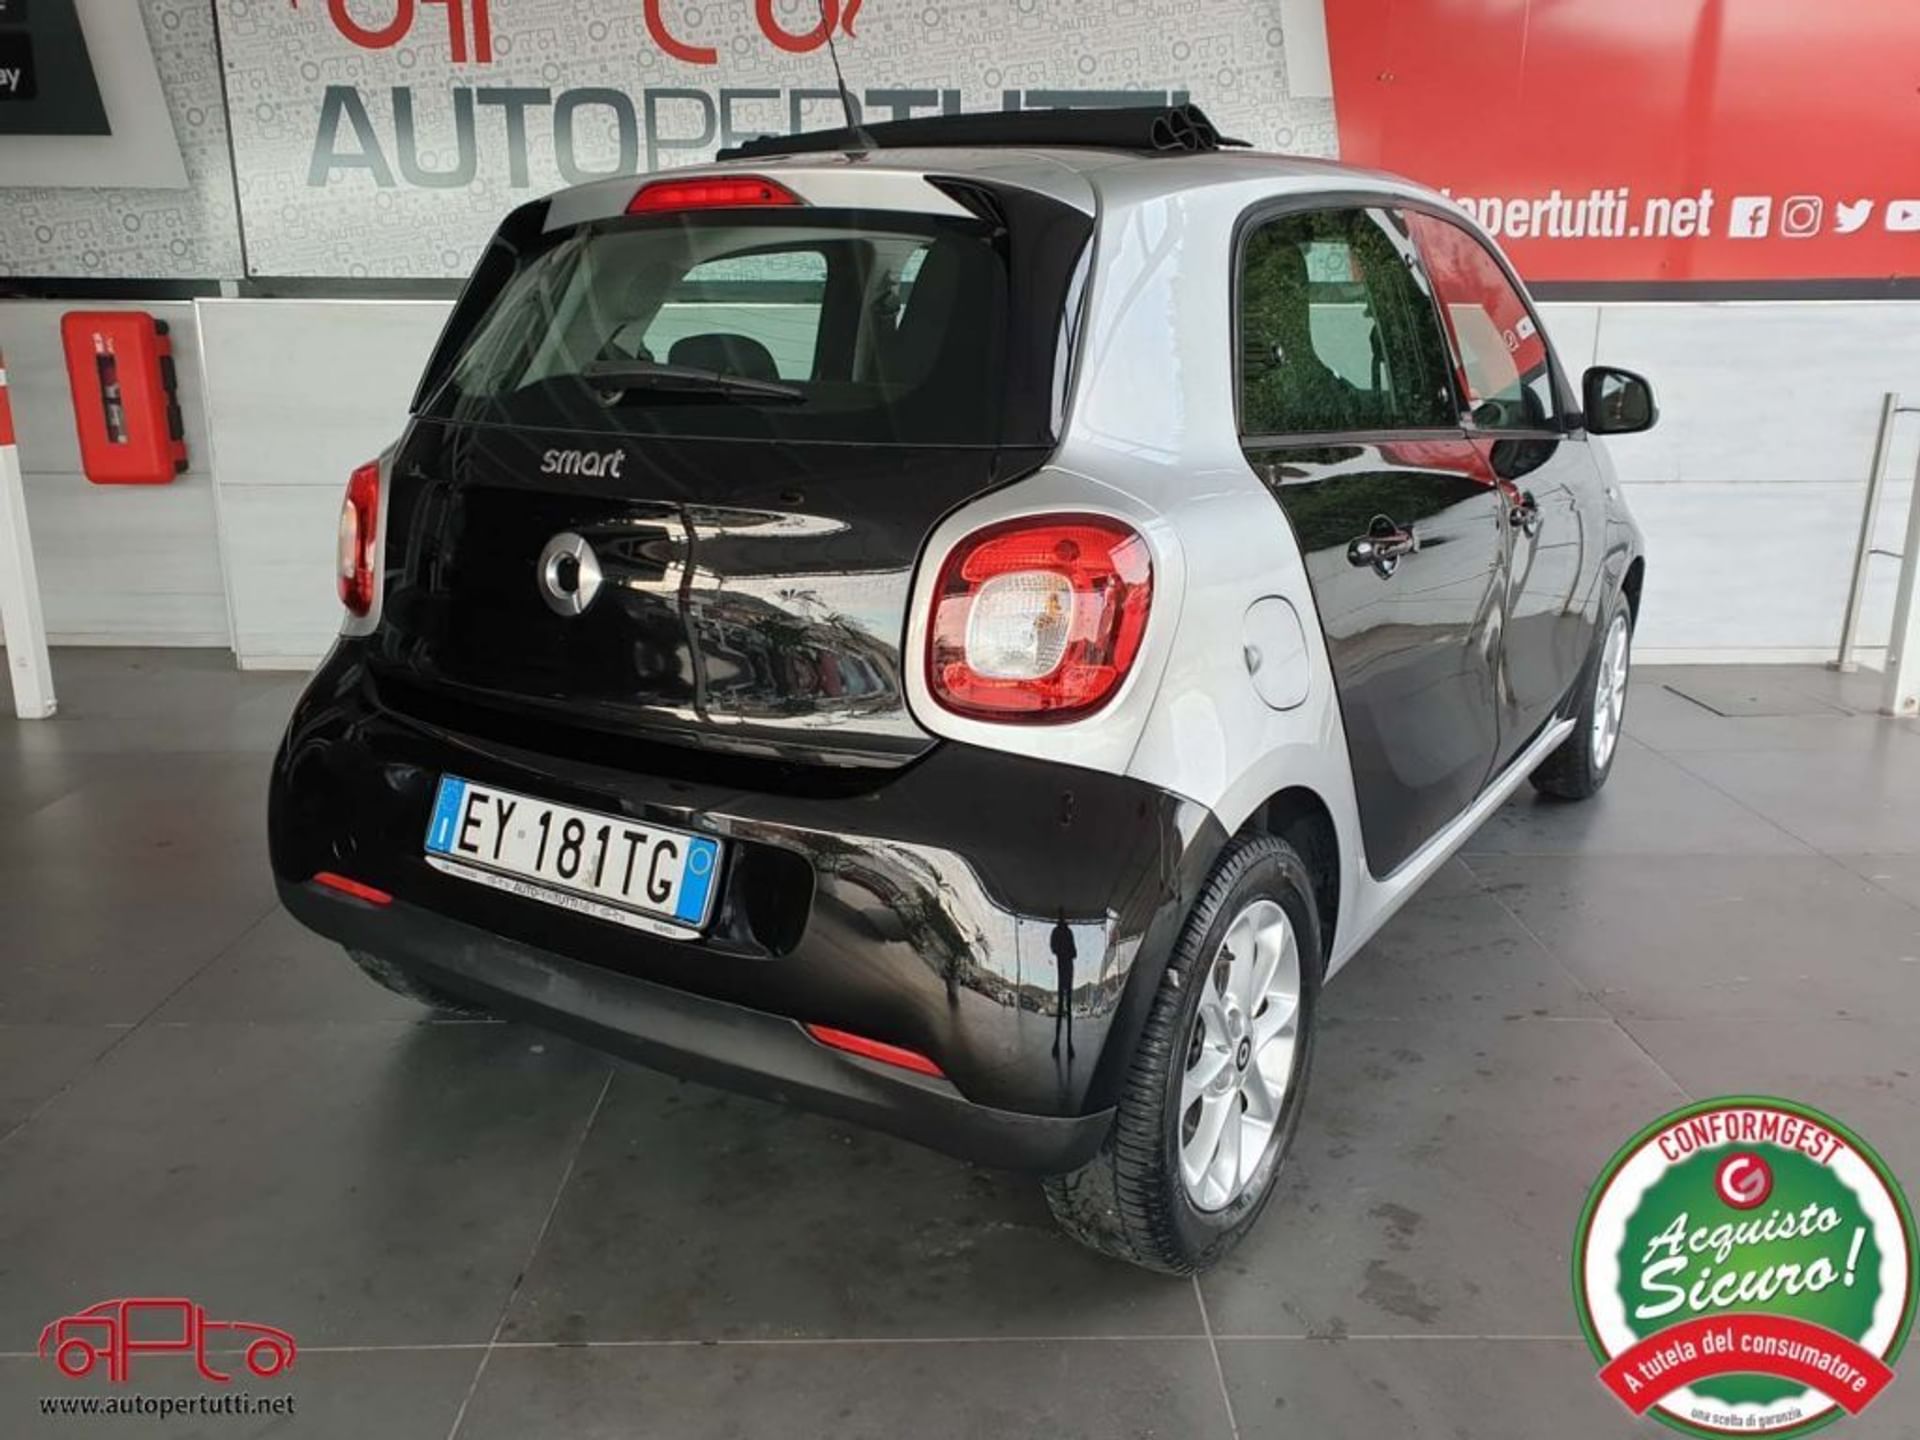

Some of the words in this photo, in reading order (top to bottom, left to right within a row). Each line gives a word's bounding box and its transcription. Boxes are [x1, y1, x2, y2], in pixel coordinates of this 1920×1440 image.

[307, 86, 1191, 188] AUTOPE
[1440, 188, 1713, 238] opertutti.net
[540, 449, 625, 478] smart
[456, 791, 516, 860] EY
[535, 810, 678, 905] 181TG
